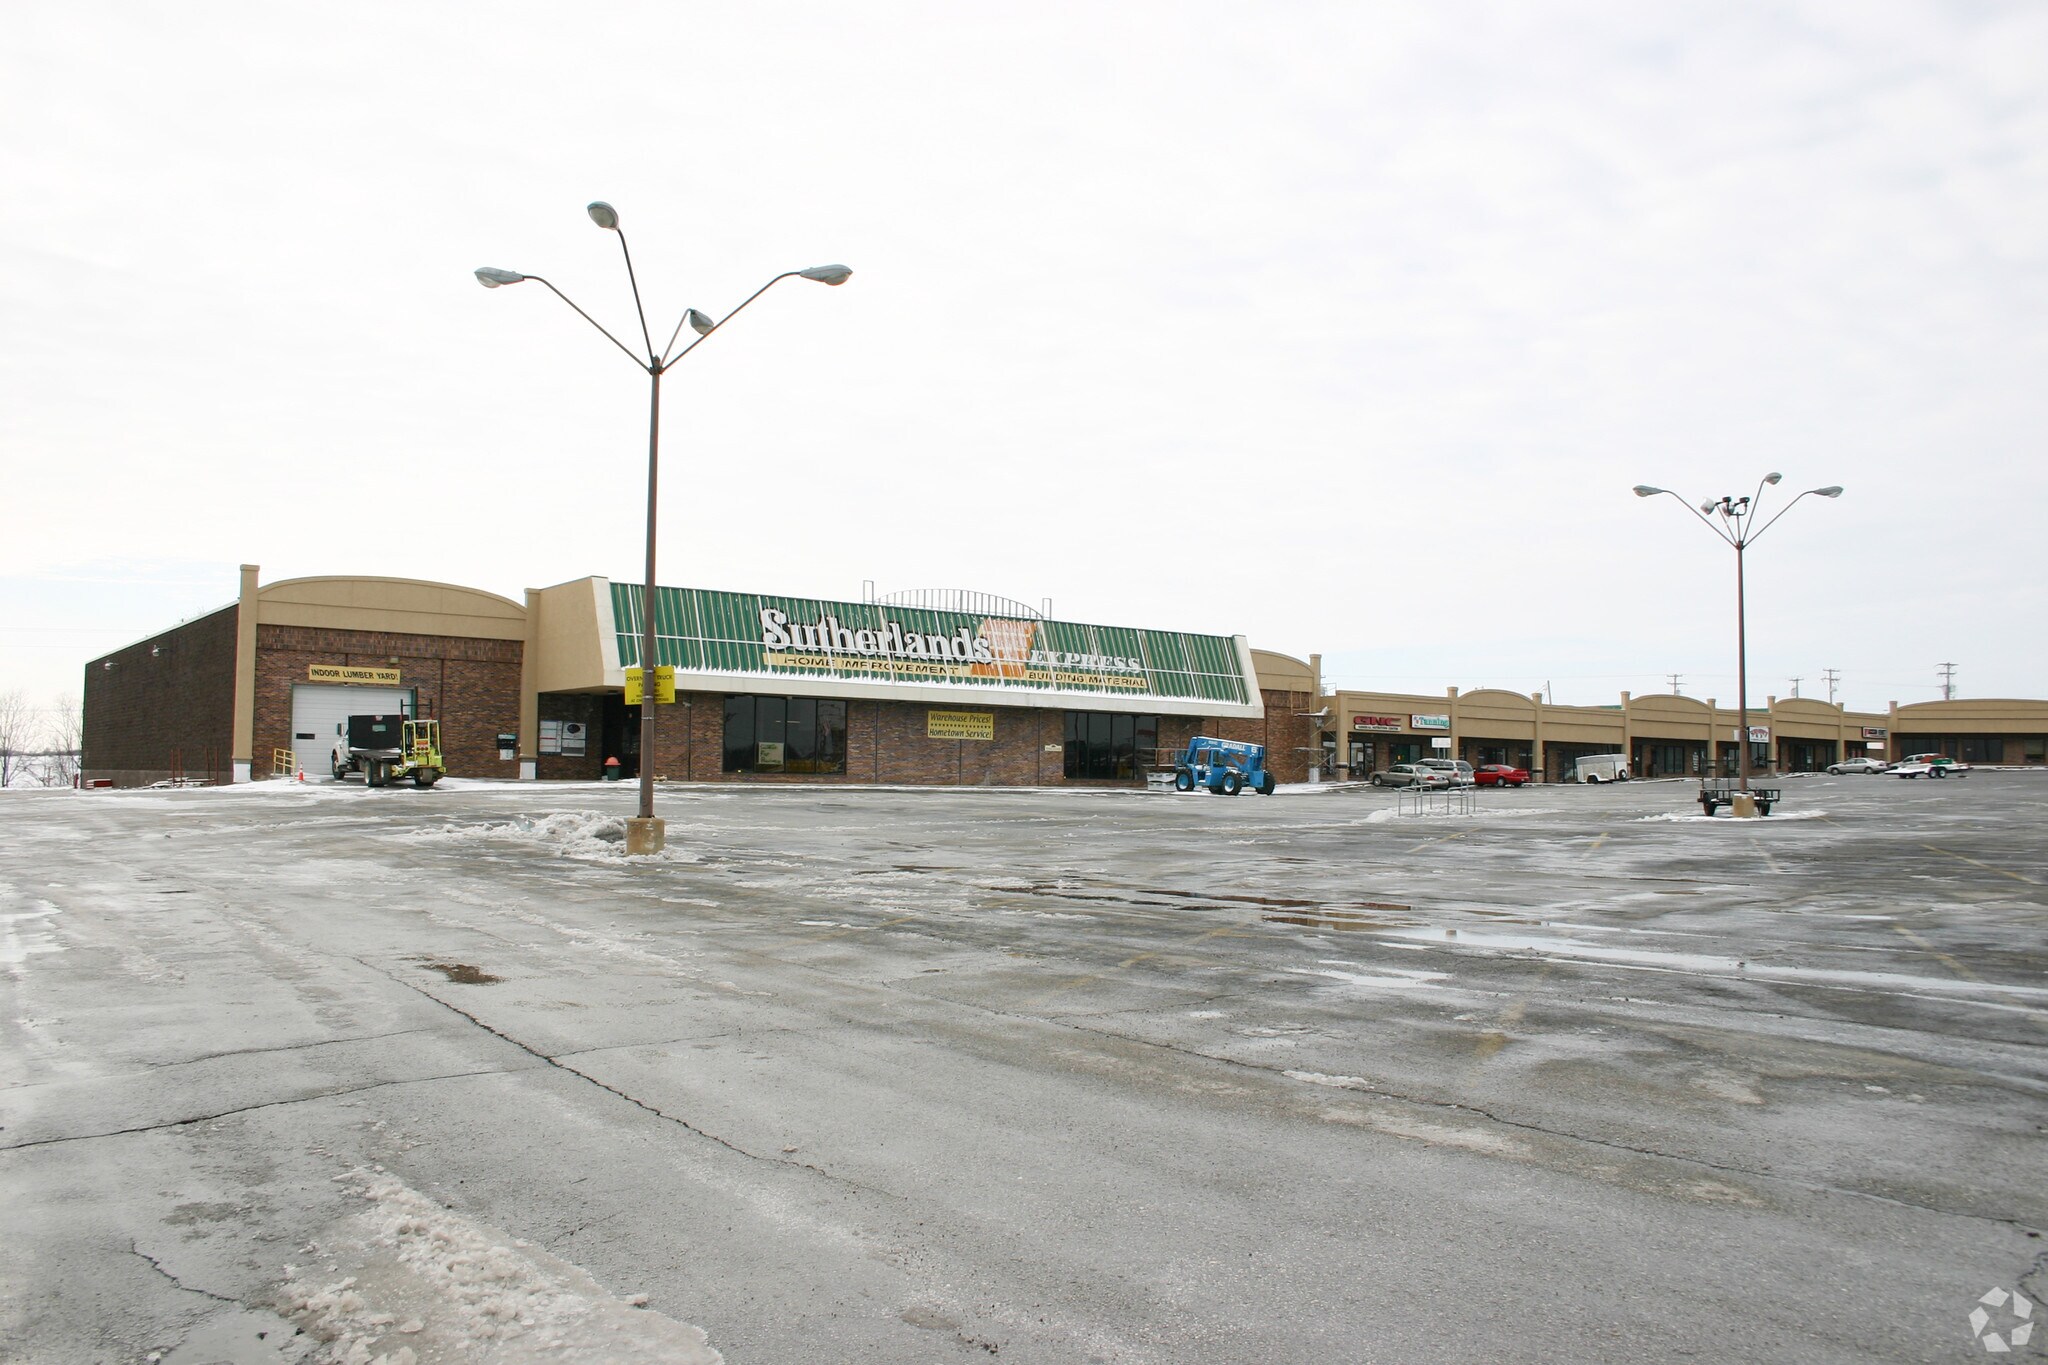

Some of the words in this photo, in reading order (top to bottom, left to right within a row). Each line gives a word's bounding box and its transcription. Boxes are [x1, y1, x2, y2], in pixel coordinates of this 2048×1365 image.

[762, 607, 993, 664] Sutherlands
[784, 657, 835, 667] HOME
[841, 660, 958, 675] IMPROVEMENT
[1029, 650, 1141, 673] EXPRESS
[311, 668, 341, 678] INDOOR
[342, 671, 374, 680] LUMBER
[376, 672, 399, 681] YARD!
[1028, 671, 1084, 683] BUILDING
[1088, 676, 1145, 687] MATERIAL
[930, 712, 967, 723] Warehouse
[969, 714, 992, 724] Prices!
[1353, 716, 1401, 727] GNC
[1420, 717, 1450, 729] Tanning
[929, 729, 964, 737] Hometown
[965, 730, 992, 739] Service!
